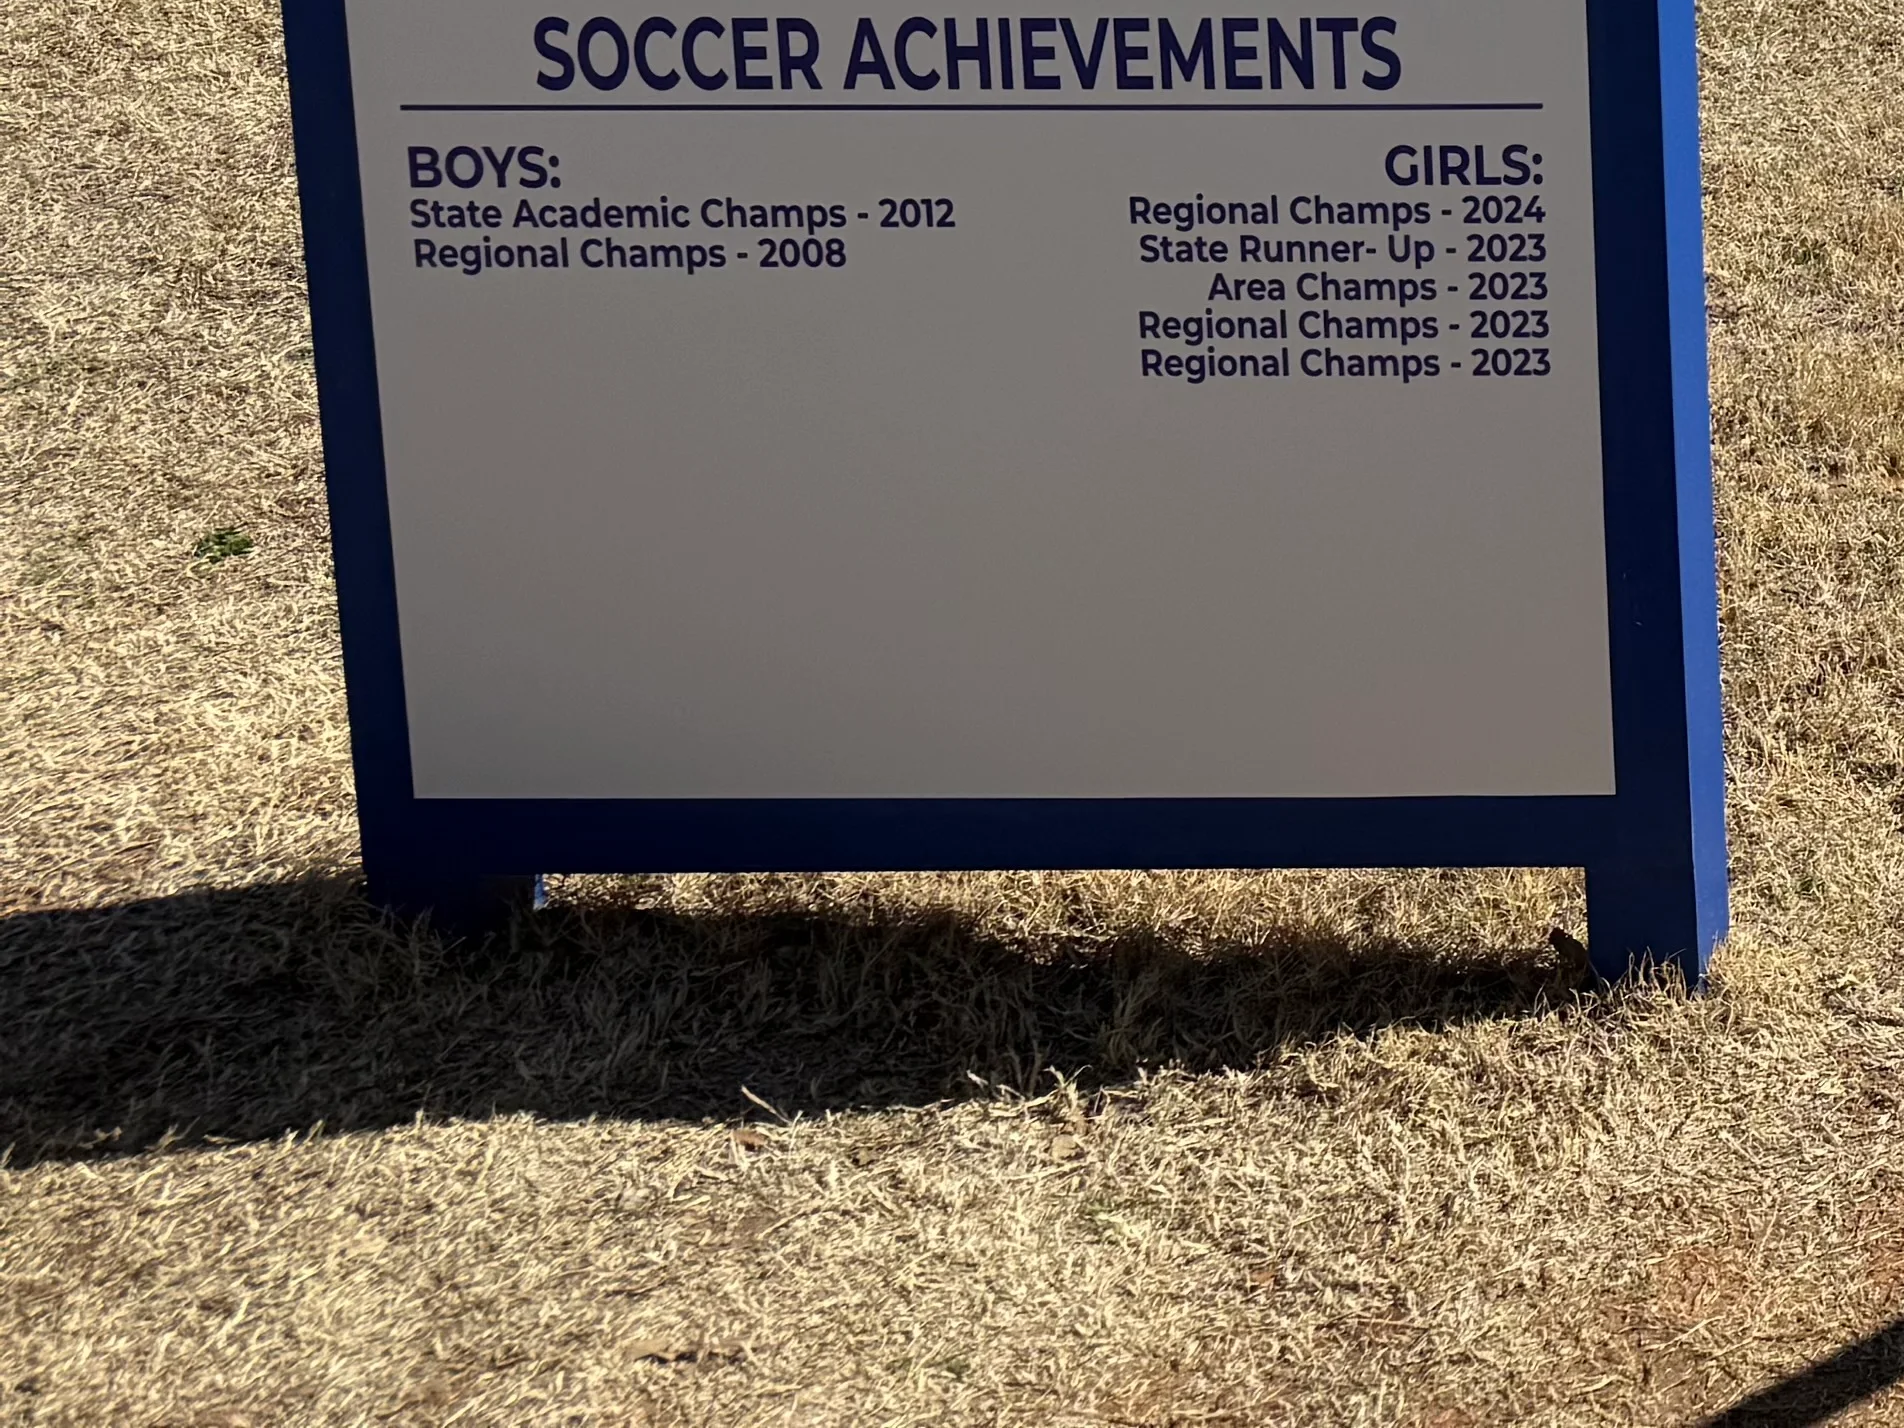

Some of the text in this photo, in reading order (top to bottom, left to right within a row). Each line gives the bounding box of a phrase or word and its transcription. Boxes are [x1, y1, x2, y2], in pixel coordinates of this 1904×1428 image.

[533, 16, 1403, 92] SOCCER ACHIEVEMENTS
[407, 145, 562, 190] BOYS:
[1385, 144, 1545, 187] GIRLS:
[410, 199, 503, 229] State
[512, 195, 691, 229] Academic
[700, 197, 848, 236] Champs
[878, 198, 957, 229] 2012
